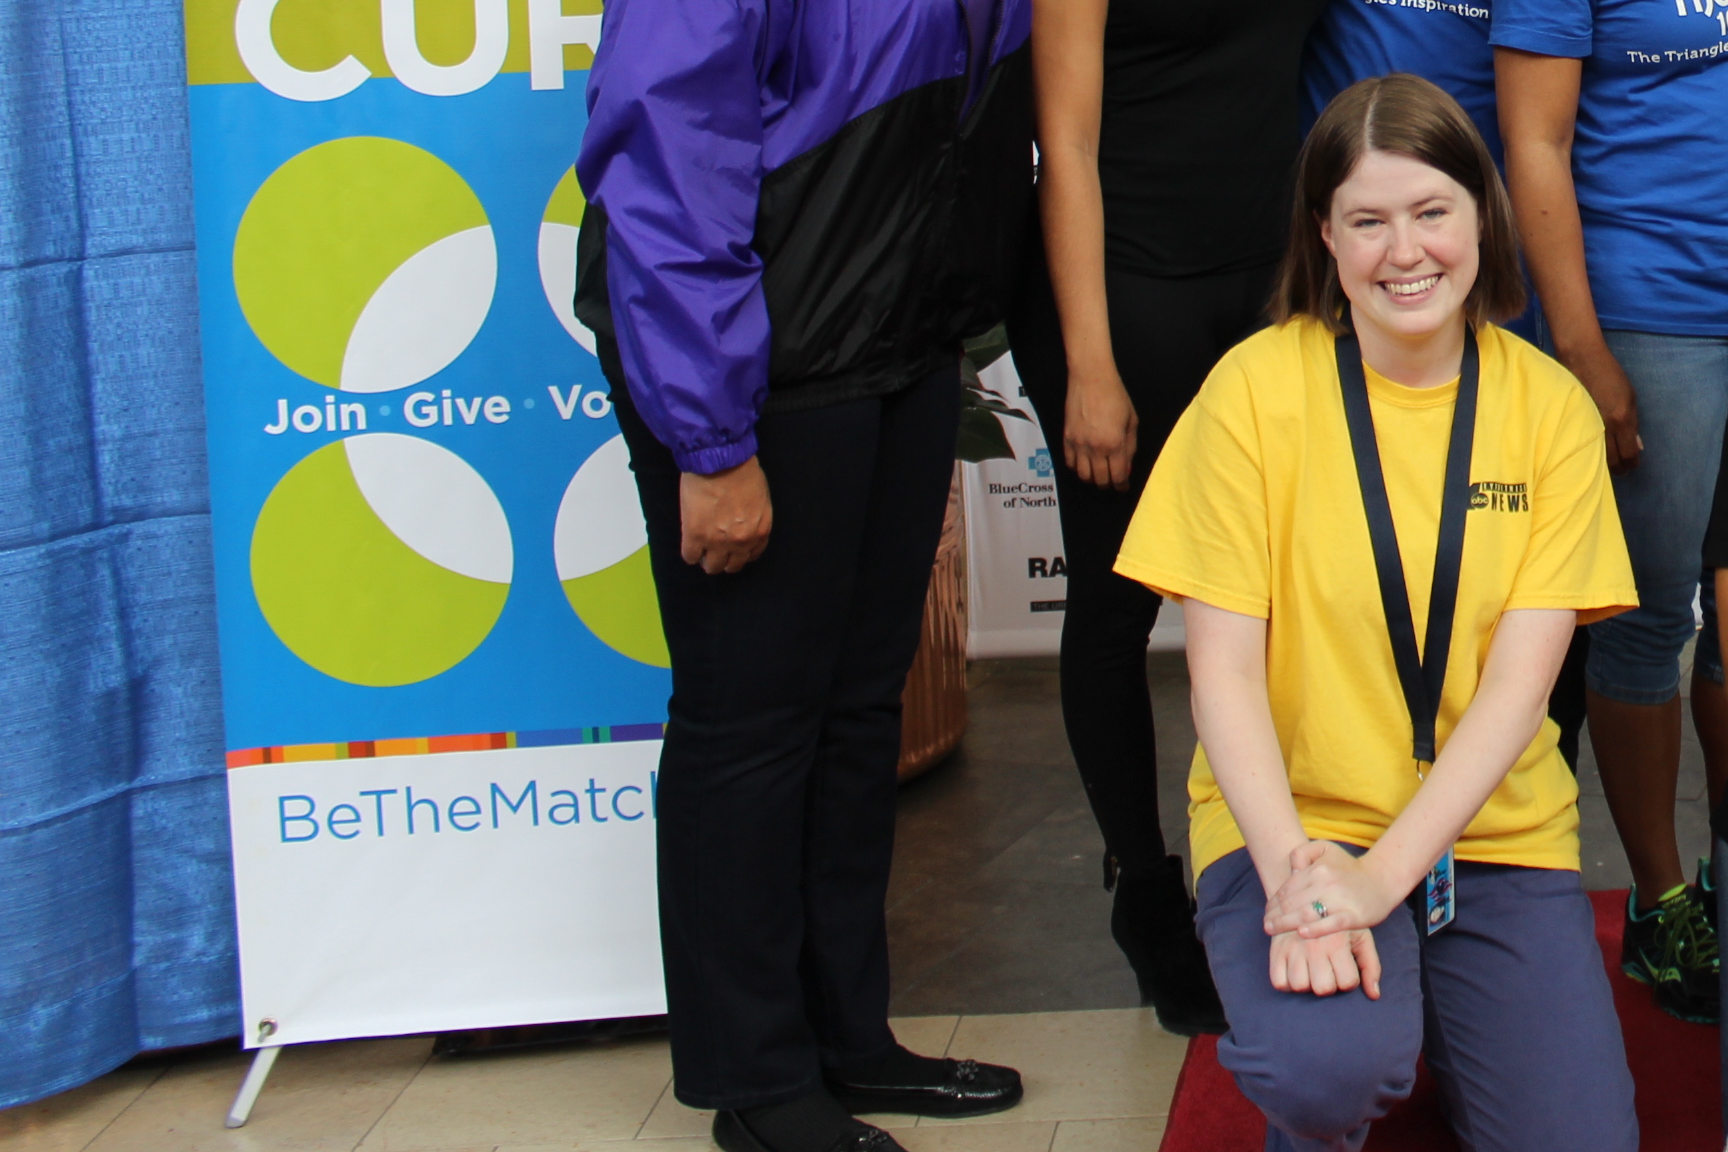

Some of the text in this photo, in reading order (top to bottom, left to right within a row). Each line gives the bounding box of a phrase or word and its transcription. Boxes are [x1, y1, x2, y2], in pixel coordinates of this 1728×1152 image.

[1627, 50, 1661, 64] The
[263, 383, 613, 436] Join Give Vo
[988, 482, 1055, 495] BlueCross
[1003, 496, 1057, 509] of North
[1491, 492, 1529, 513] NEWS
[277, 769, 658, 845] BeTheMatc
